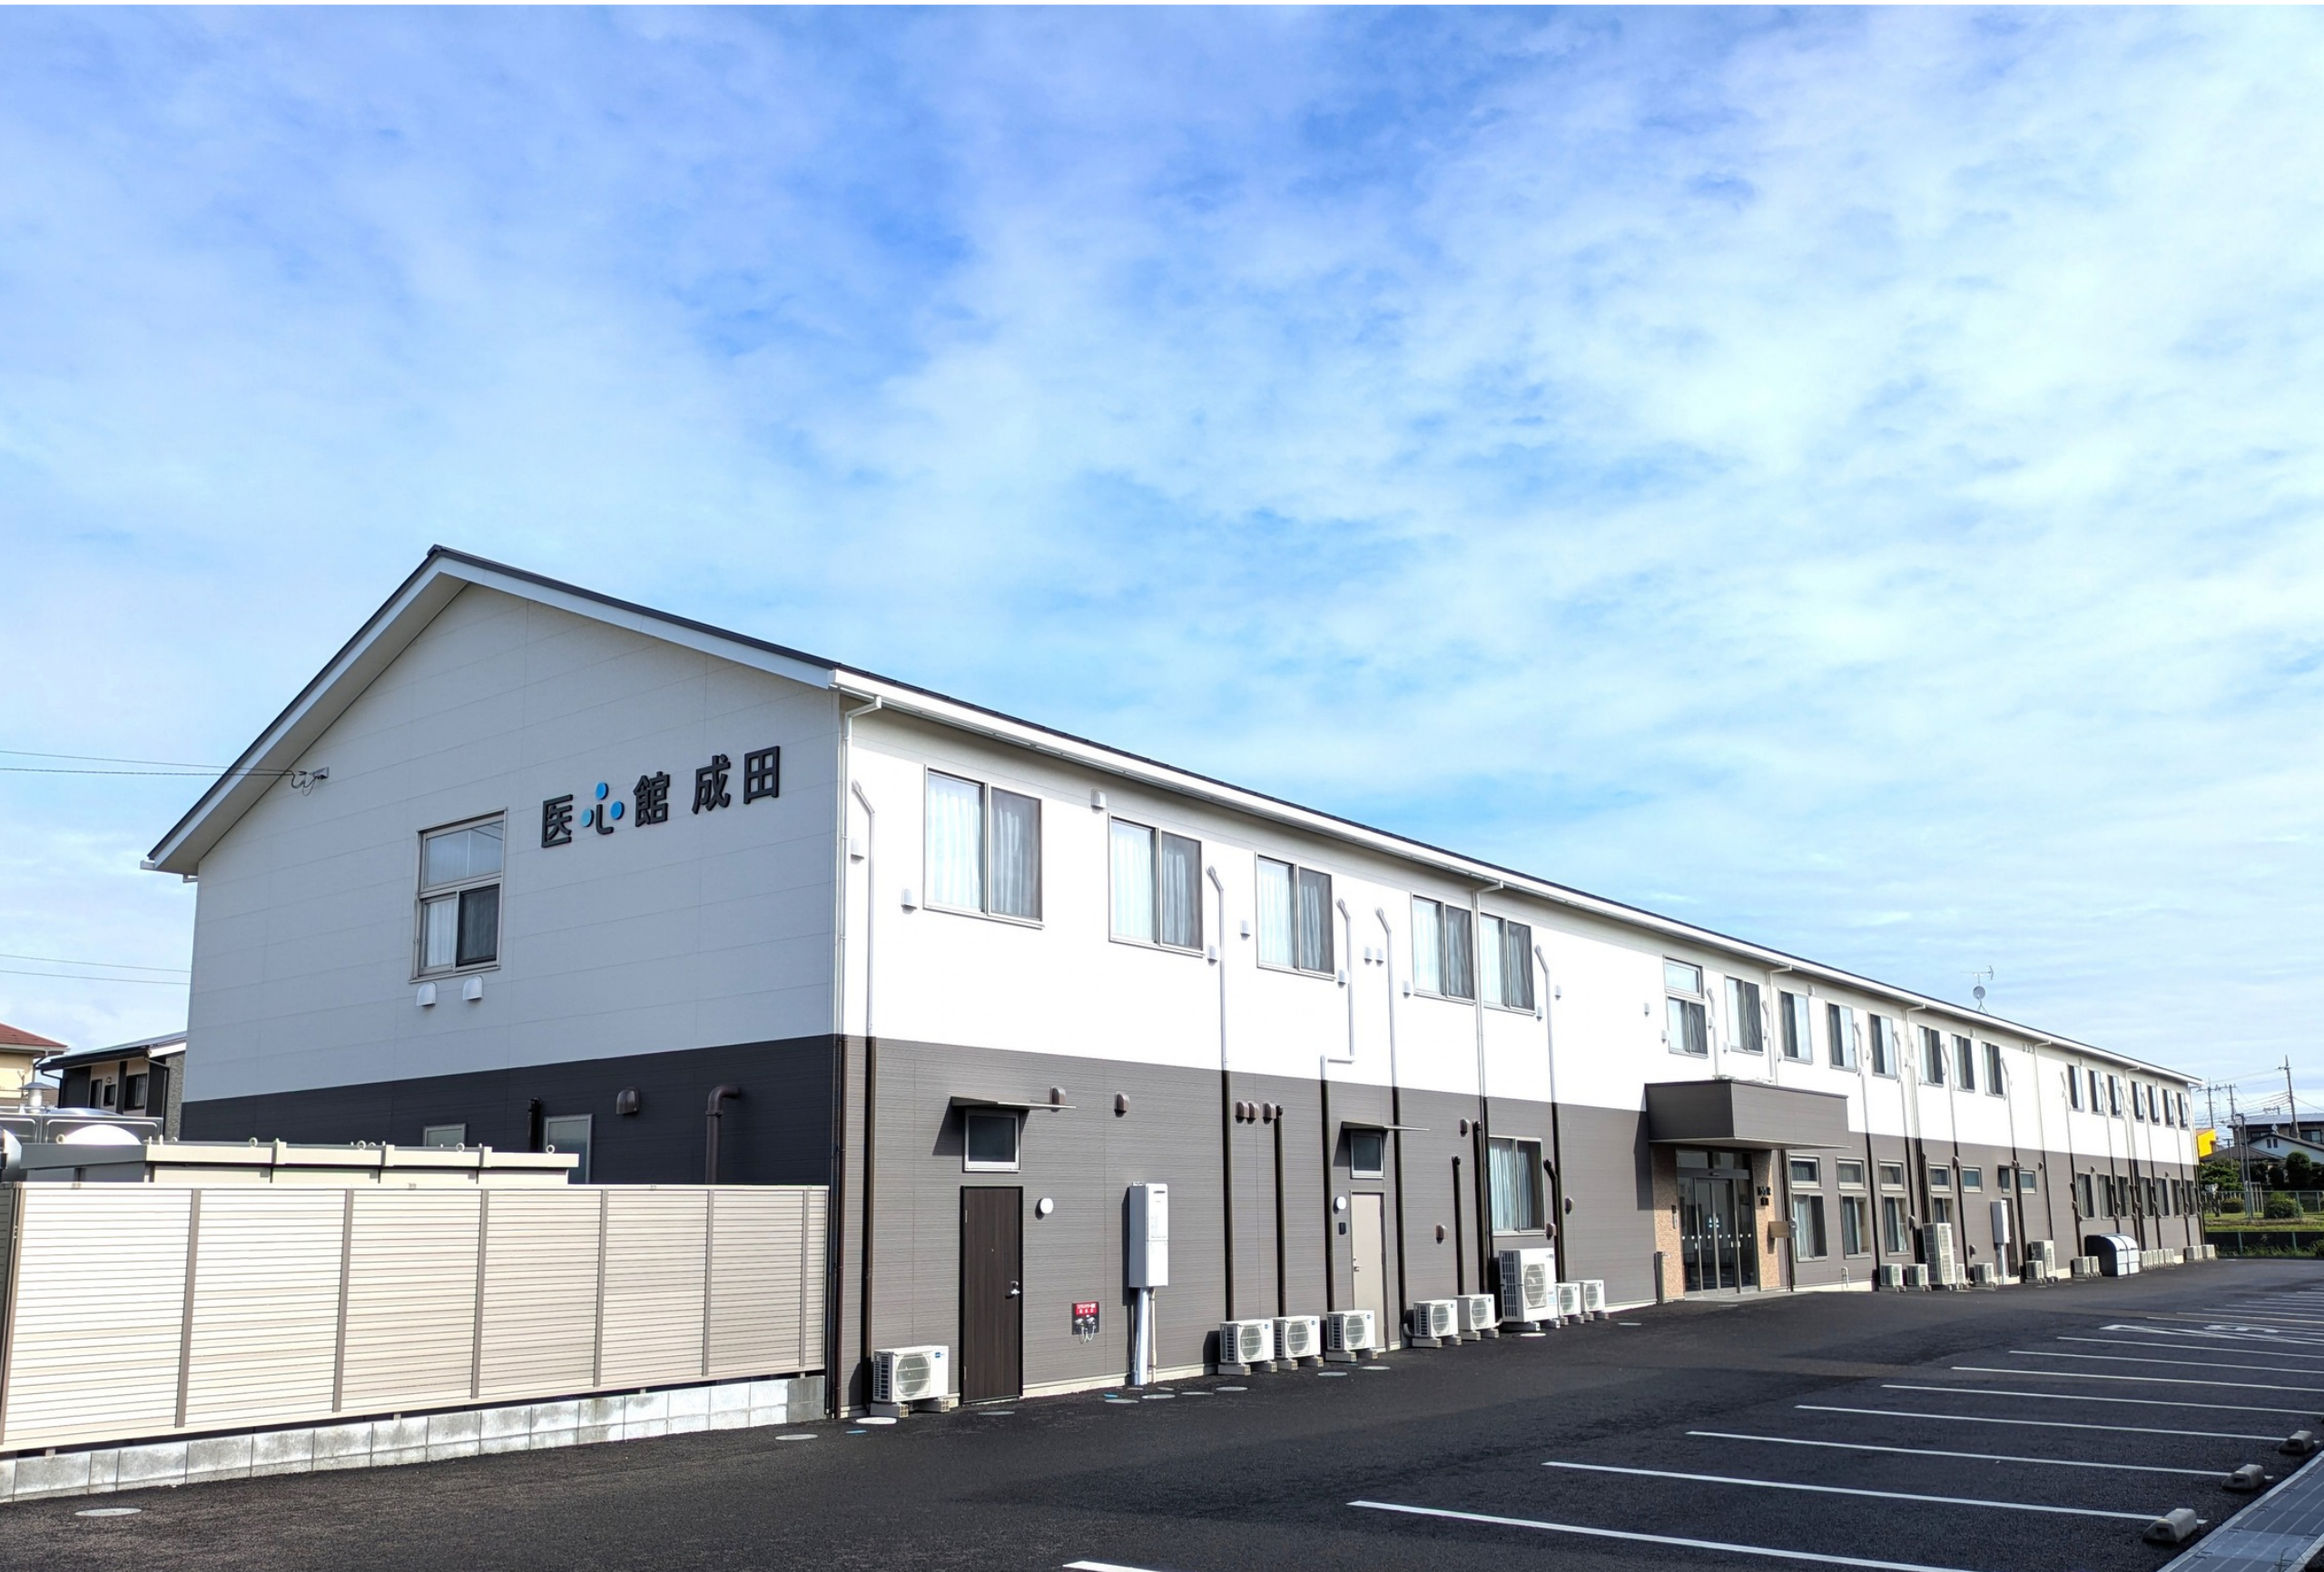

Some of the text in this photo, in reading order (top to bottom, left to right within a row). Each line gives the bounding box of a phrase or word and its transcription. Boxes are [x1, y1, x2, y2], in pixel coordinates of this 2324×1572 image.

[541, 745, 781, 849] 医心館 成田
